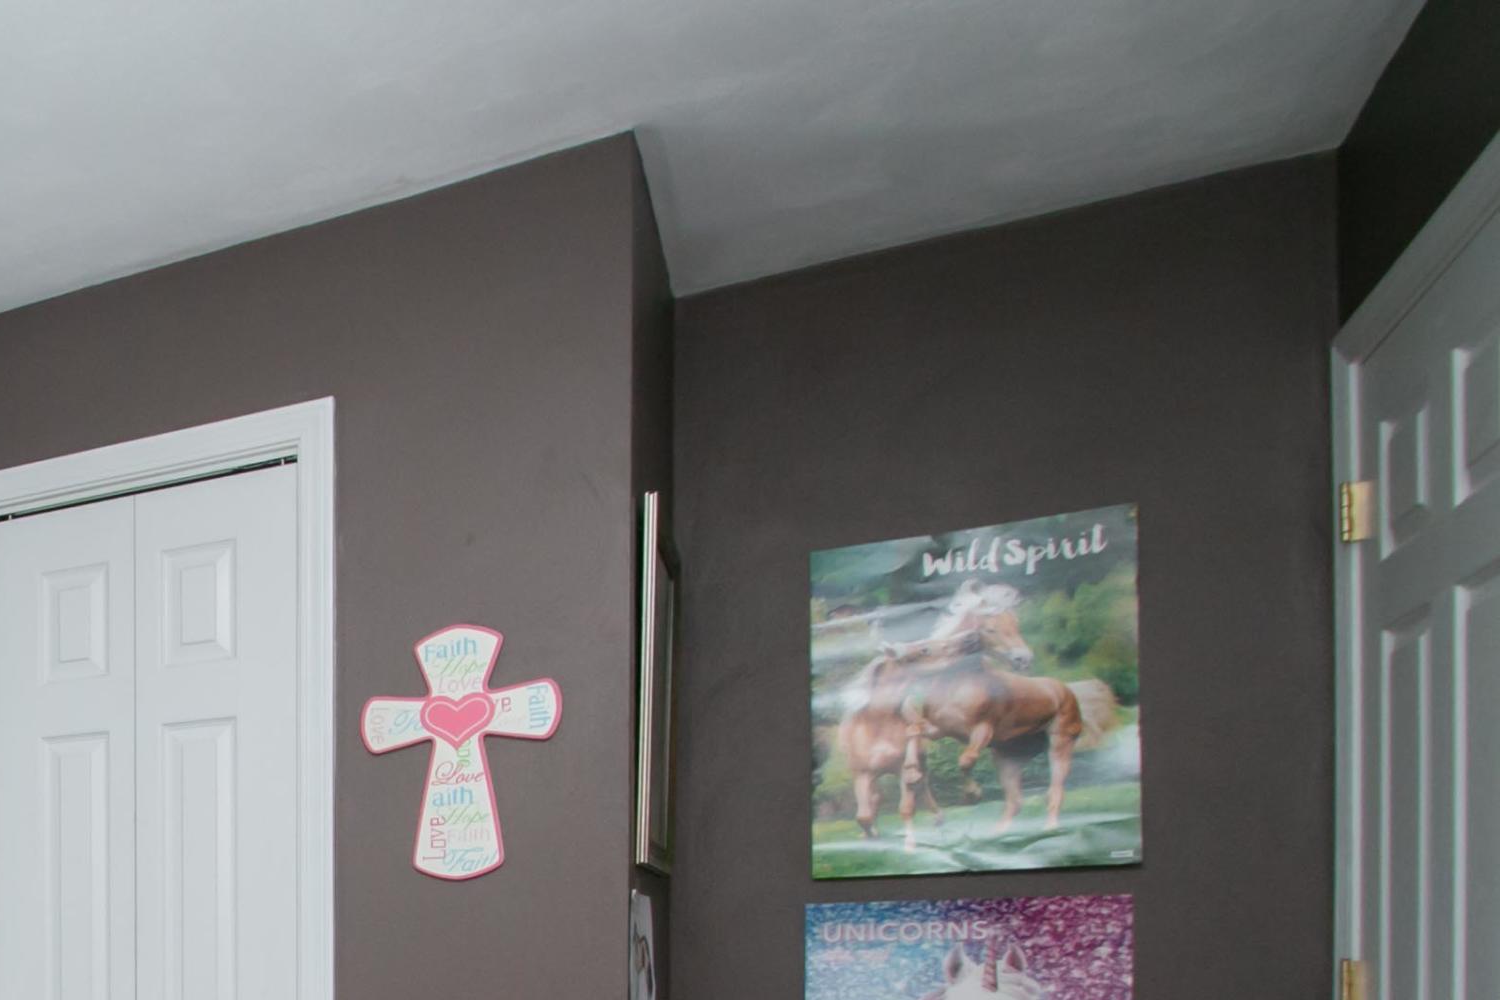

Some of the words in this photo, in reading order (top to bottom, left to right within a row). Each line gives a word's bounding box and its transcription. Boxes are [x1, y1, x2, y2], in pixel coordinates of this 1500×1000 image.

[922, 537, 999, 577] Wild
[1003, 523, 1108, 575] Spirit
[424, 636, 477, 663] Faith
[526, 684, 551, 730] Faith
[822, 920, 988, 942] UNICORNS
